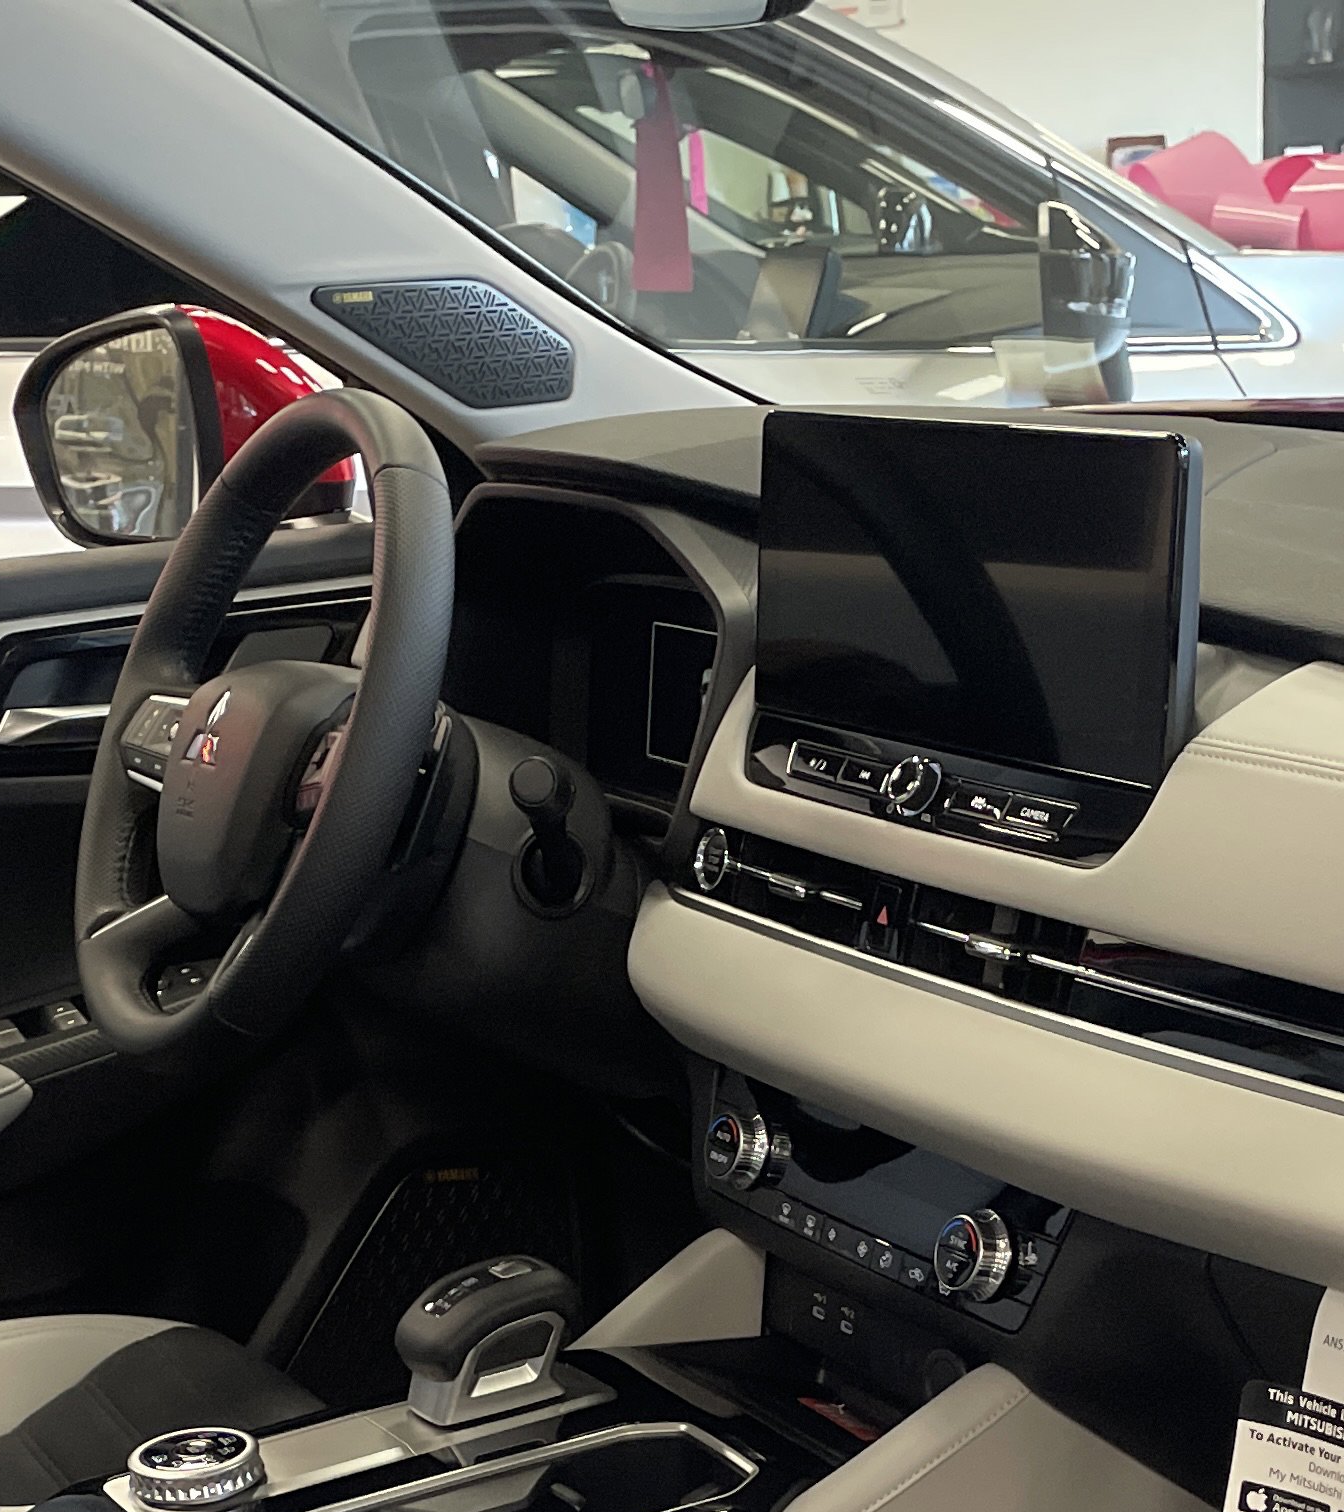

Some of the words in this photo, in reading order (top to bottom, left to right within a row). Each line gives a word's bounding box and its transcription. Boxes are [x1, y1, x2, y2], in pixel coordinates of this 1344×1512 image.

[1268, 1387, 1295, 1405] This
[1299, 1395, 1337, 1419] Vehicle
[1249, 1428, 1264, 1441] To
[1266, 1432, 1316, 1456] Activate
[1318, 1446, 1342, 1464] Your
[1268, 1466, 1287, 1483] My
[1289, 1472, 1343, 1500] Mitsubishi
